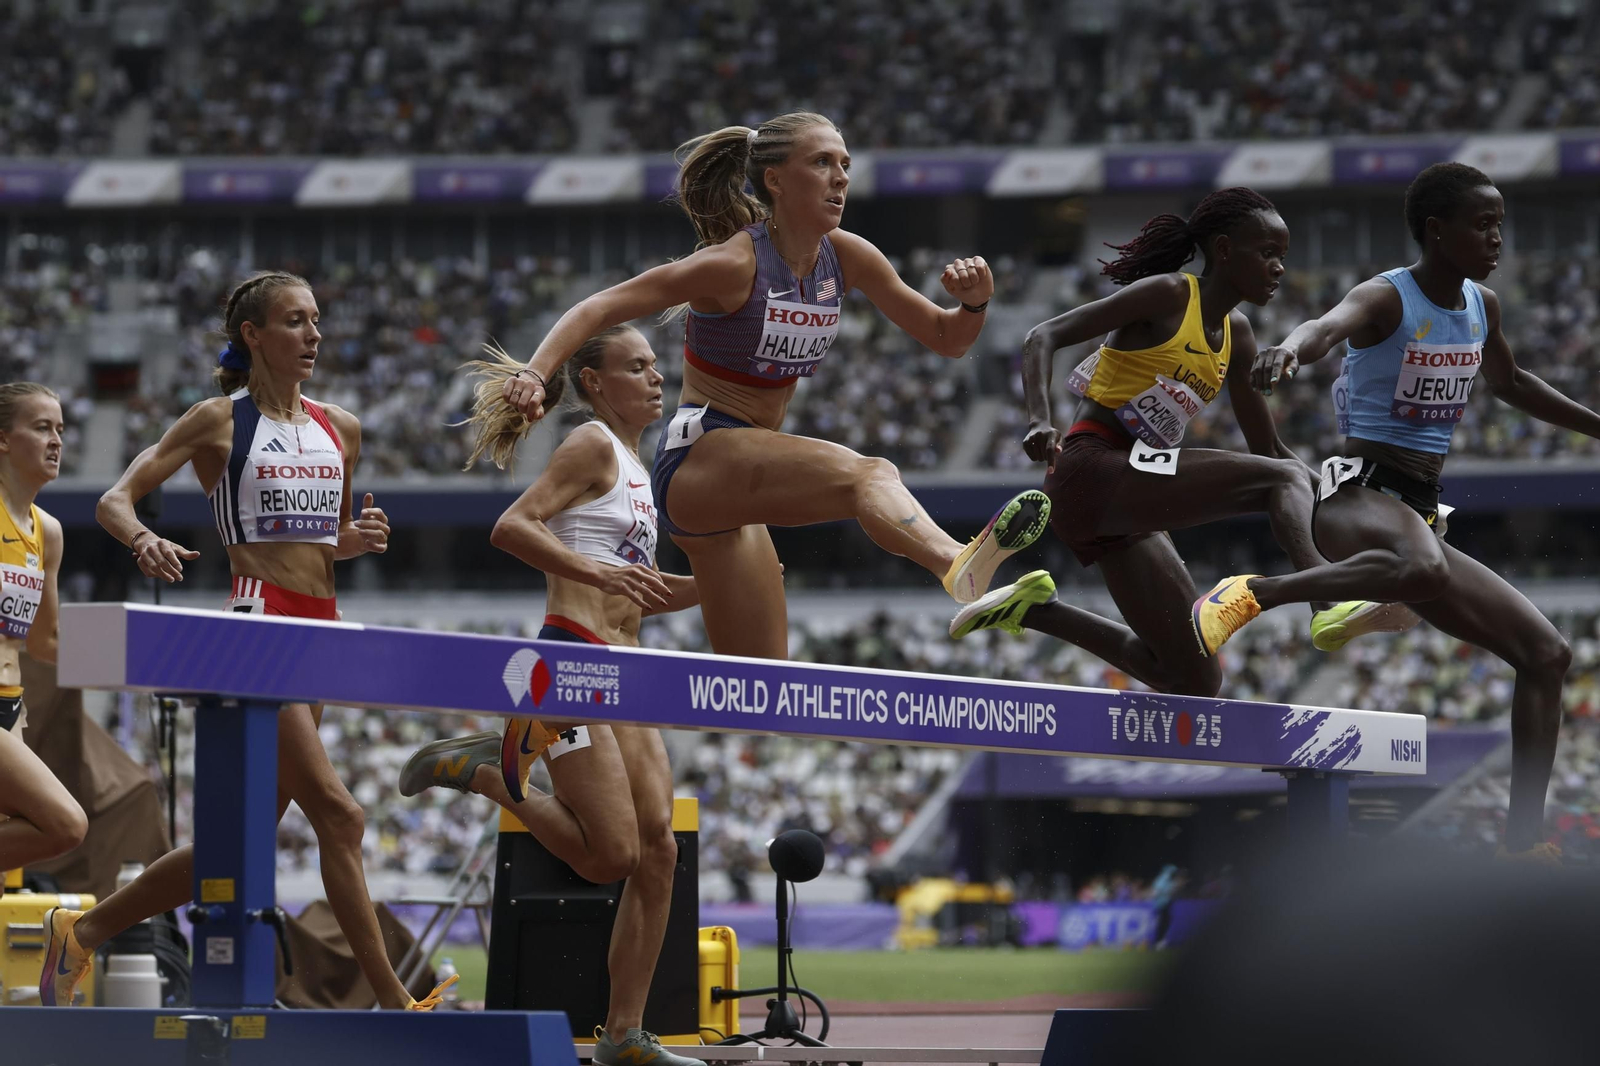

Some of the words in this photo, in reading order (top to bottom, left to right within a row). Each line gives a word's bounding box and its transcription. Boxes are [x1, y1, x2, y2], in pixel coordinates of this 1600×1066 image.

[767, 307, 840, 328] HOND
[1405, 350, 1481, 368] HONDA
[1173, 364, 1219, 402] UGAND
[255, 465, 342, 480] HONDA
[260, 488, 340, 513] RENOUARD
[556, 661, 582, 674] WORLD
[582, 662, 620, 677] ATHLETICS
[555, 673, 620, 690] CHAMPIONSHIPS
[689, 674, 769, 714] WORLD
[775, 681, 889, 724] ATHLETICS
[894, 691, 1057, 736] CHAMPIONSHIPS
[1390, 738, 1421, 763] NISHI
